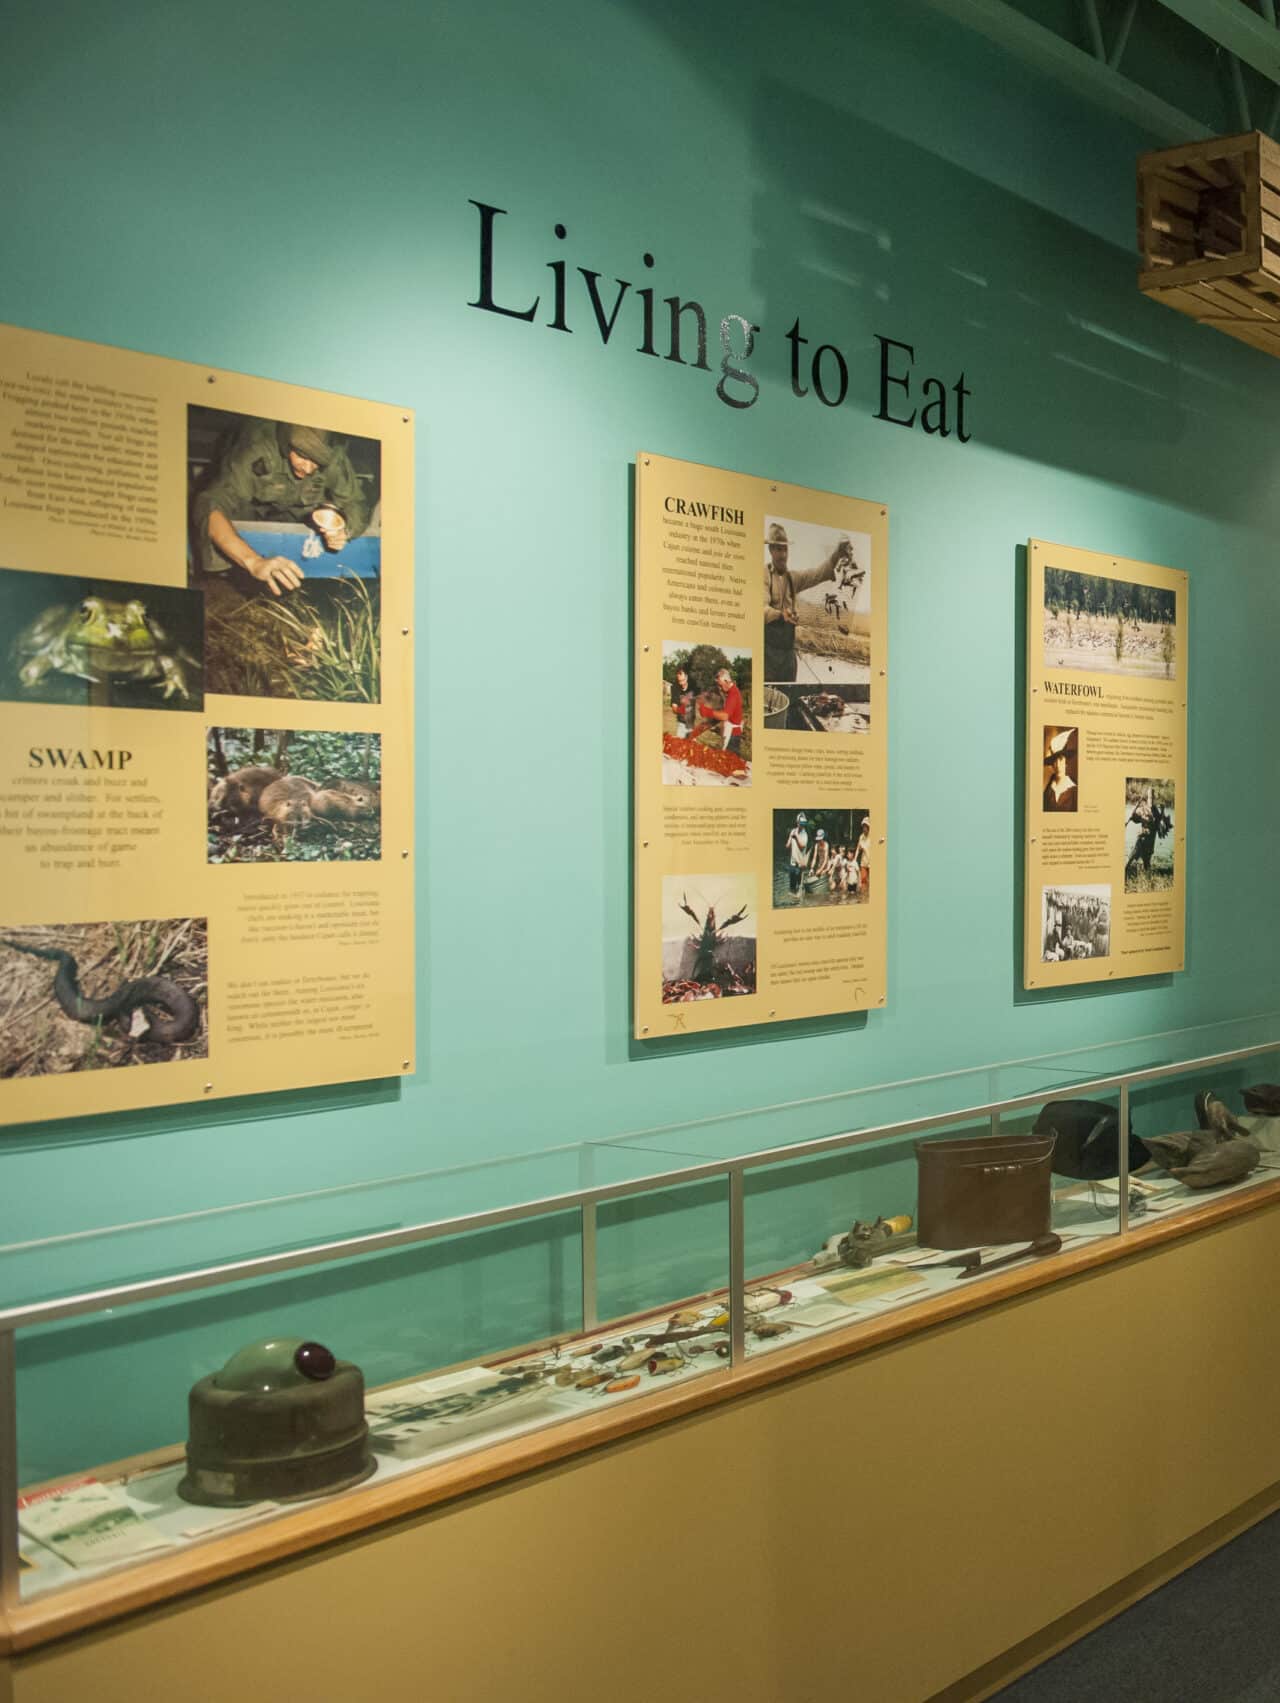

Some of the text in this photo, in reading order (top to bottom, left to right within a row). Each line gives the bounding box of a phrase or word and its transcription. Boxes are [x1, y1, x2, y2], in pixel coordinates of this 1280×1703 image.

[466, 199, 972, 444] Living to Eat
[664, 496, 744, 526] CRAWFISH
[1044, 681, 1104, 699] WATERFOWL
[28, 747, 132, 770] SWAMP
